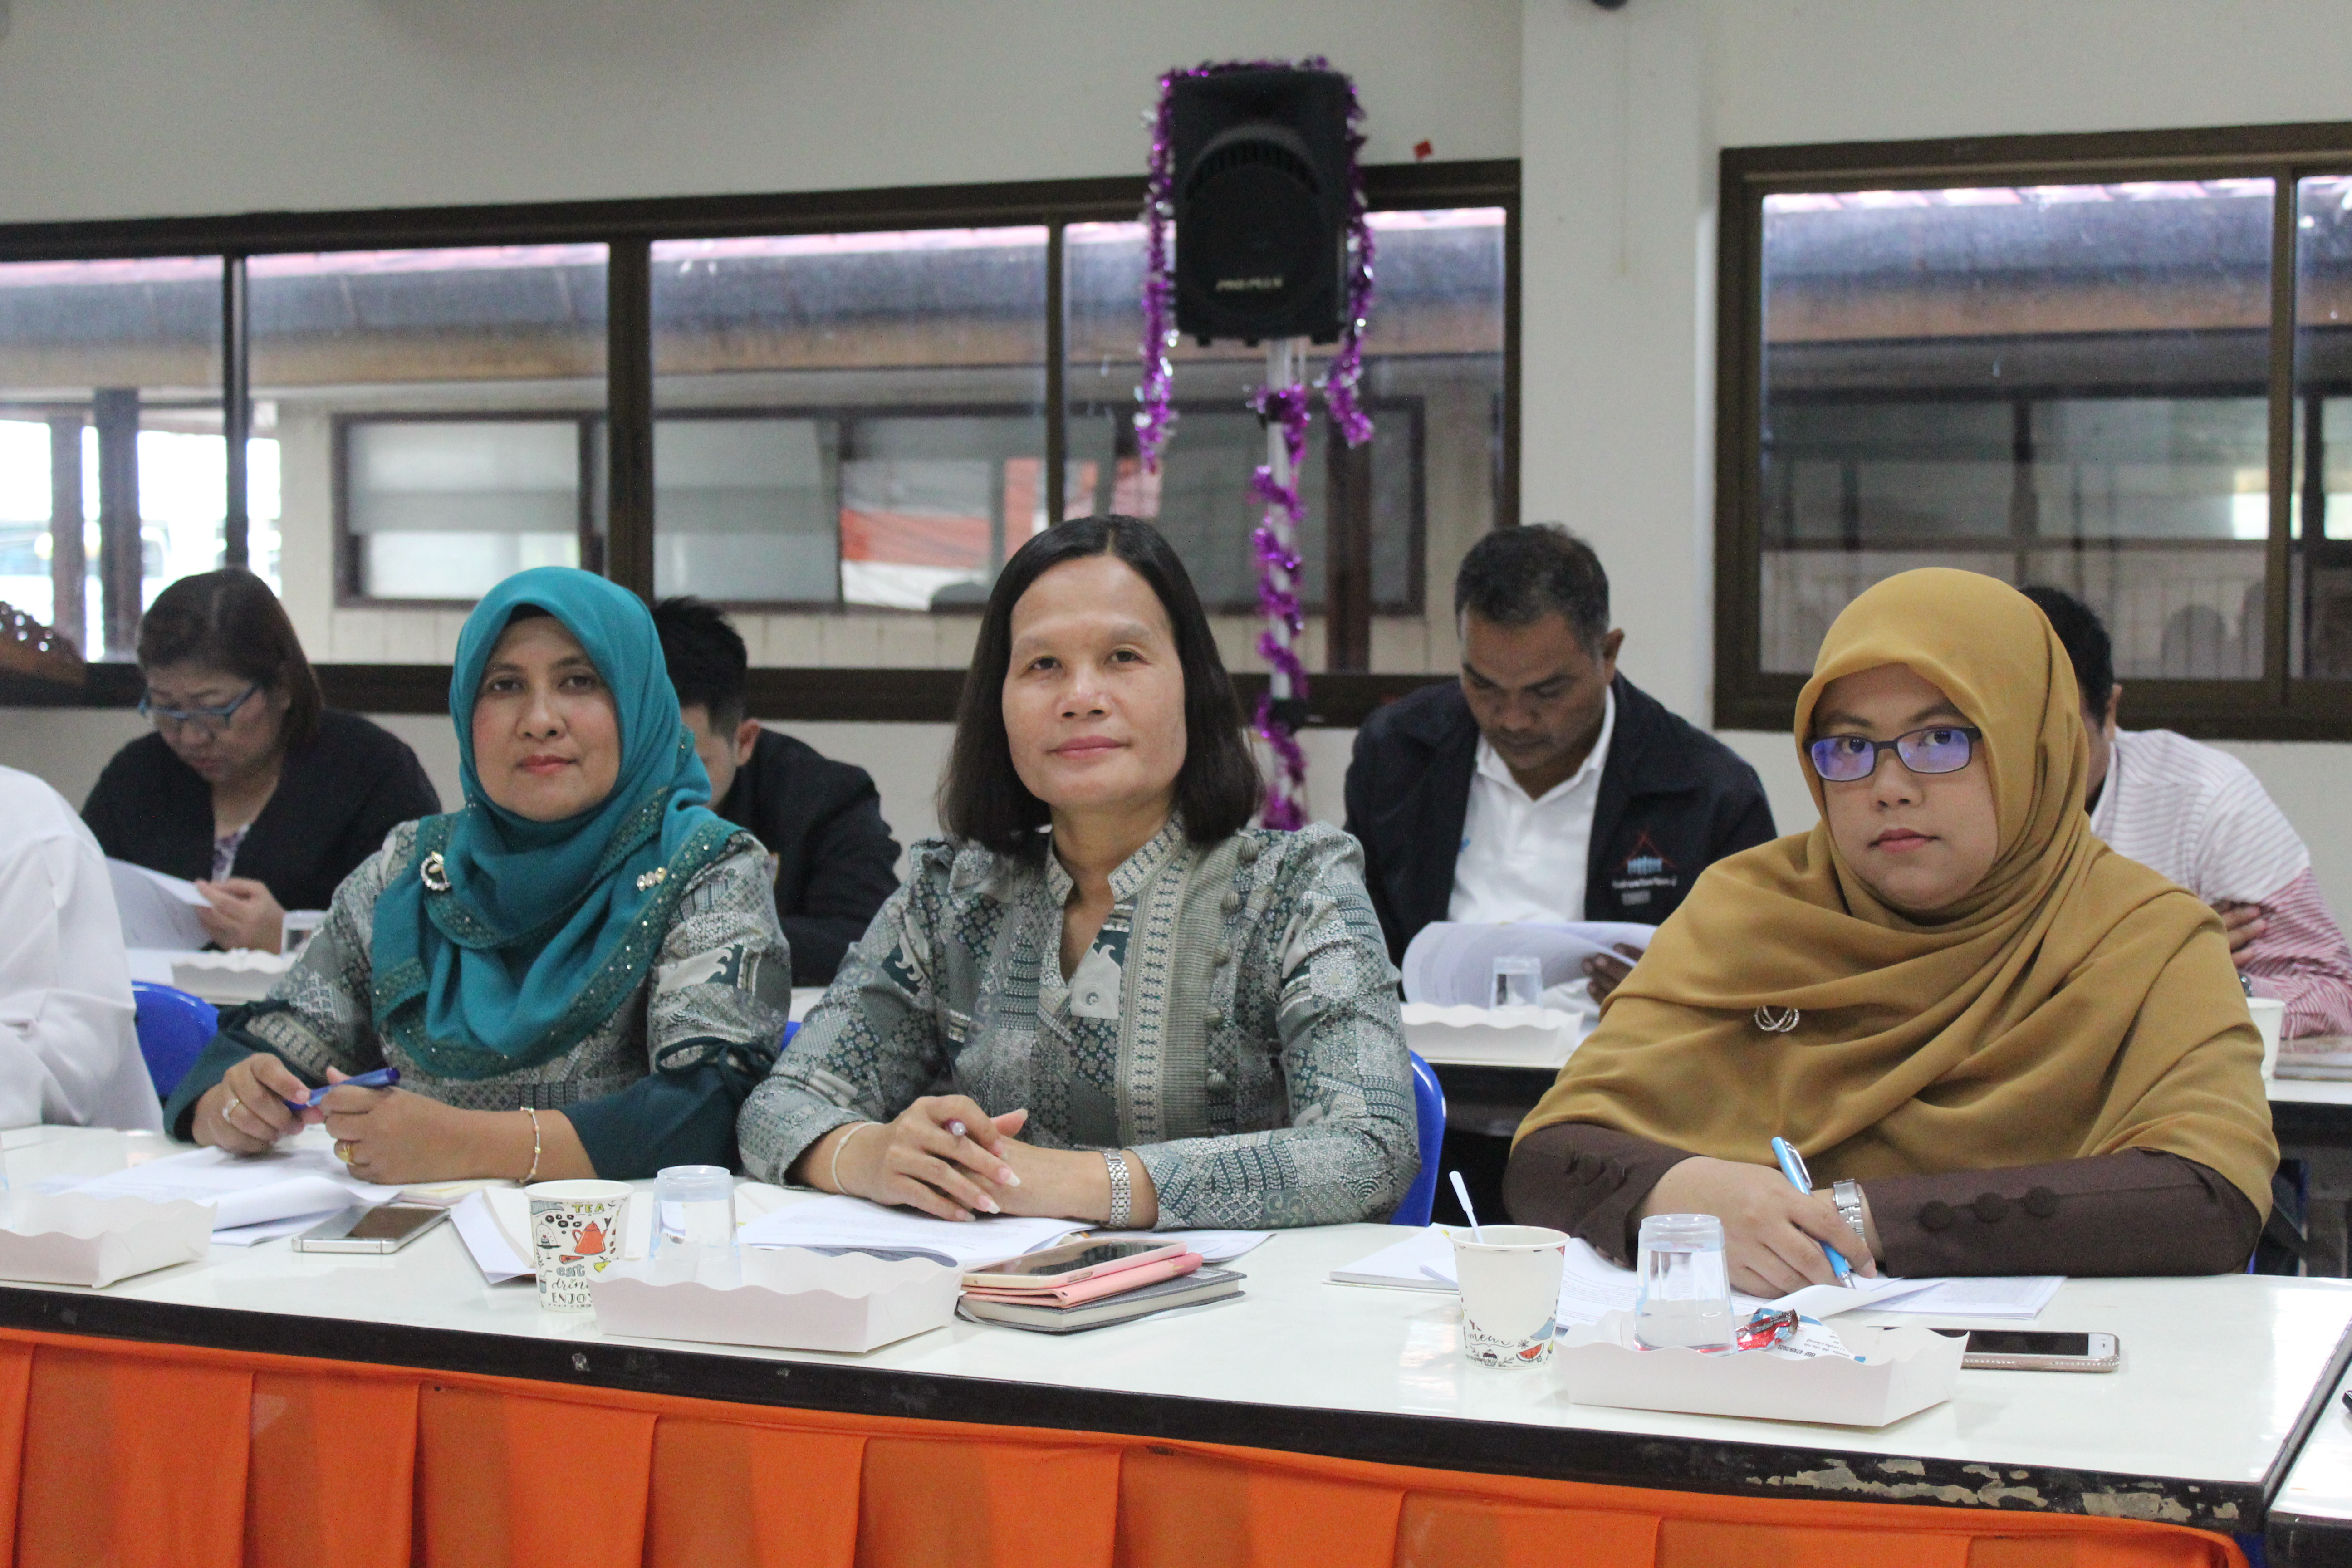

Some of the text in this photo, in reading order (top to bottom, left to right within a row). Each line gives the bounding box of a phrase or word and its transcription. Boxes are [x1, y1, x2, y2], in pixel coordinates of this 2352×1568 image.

[572, 1203, 605, 1213] TEA
[556, 1264, 585, 1277] eat
[552, 1278, 588, 1291] drin
